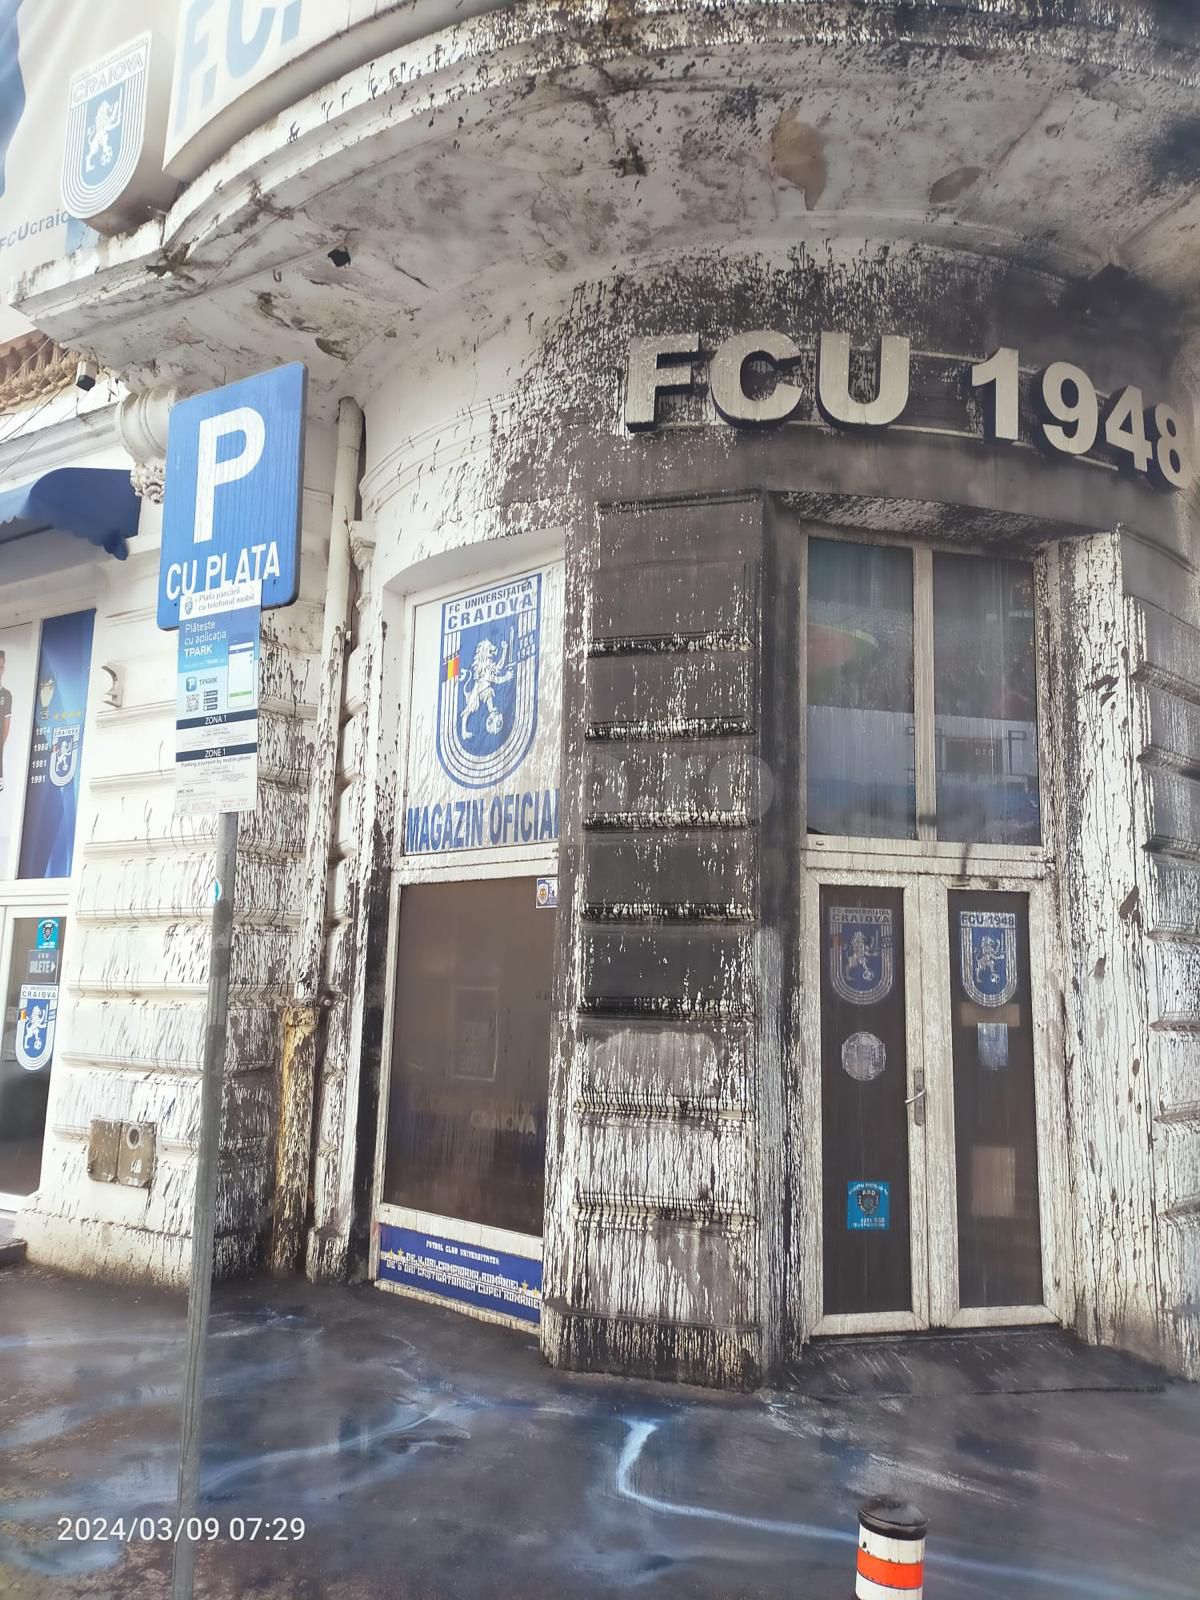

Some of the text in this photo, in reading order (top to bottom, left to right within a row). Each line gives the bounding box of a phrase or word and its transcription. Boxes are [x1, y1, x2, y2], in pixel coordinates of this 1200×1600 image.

[73, 52, 144, 103] CRAIOVA
[626, 330, 1192, 490] FCU 1948
[194, 406, 266, 544] P
[166, 541, 280, 600] CU PLATA
[449, 580, 533, 614] FC UNIVERSITATEA
[448, 593, 533, 630] CRAIOVA
[184, 637, 194, 645] cu
[184, 643, 213, 658] TPARK
[204, 716, 223, 725] ZONA
[204, 749, 222, 758] ZONE
[30, 775, 46, 784] 1991
[406, 798, 484, 852] MAGAZIN
[832, 913, 890, 923] CRAIOVA
[962, 914, 1014, 926] FCU 1948
[22, 990, 57, 998] CRAIOVA
[405, 1252, 416, 1262] DE
[424, 1257, 437, 1269] ORI
[386, 1259, 396, 1269] DE
[404, 1263, 416, 1275] ORI
[477, 1283, 502, 1299] CUPEI
